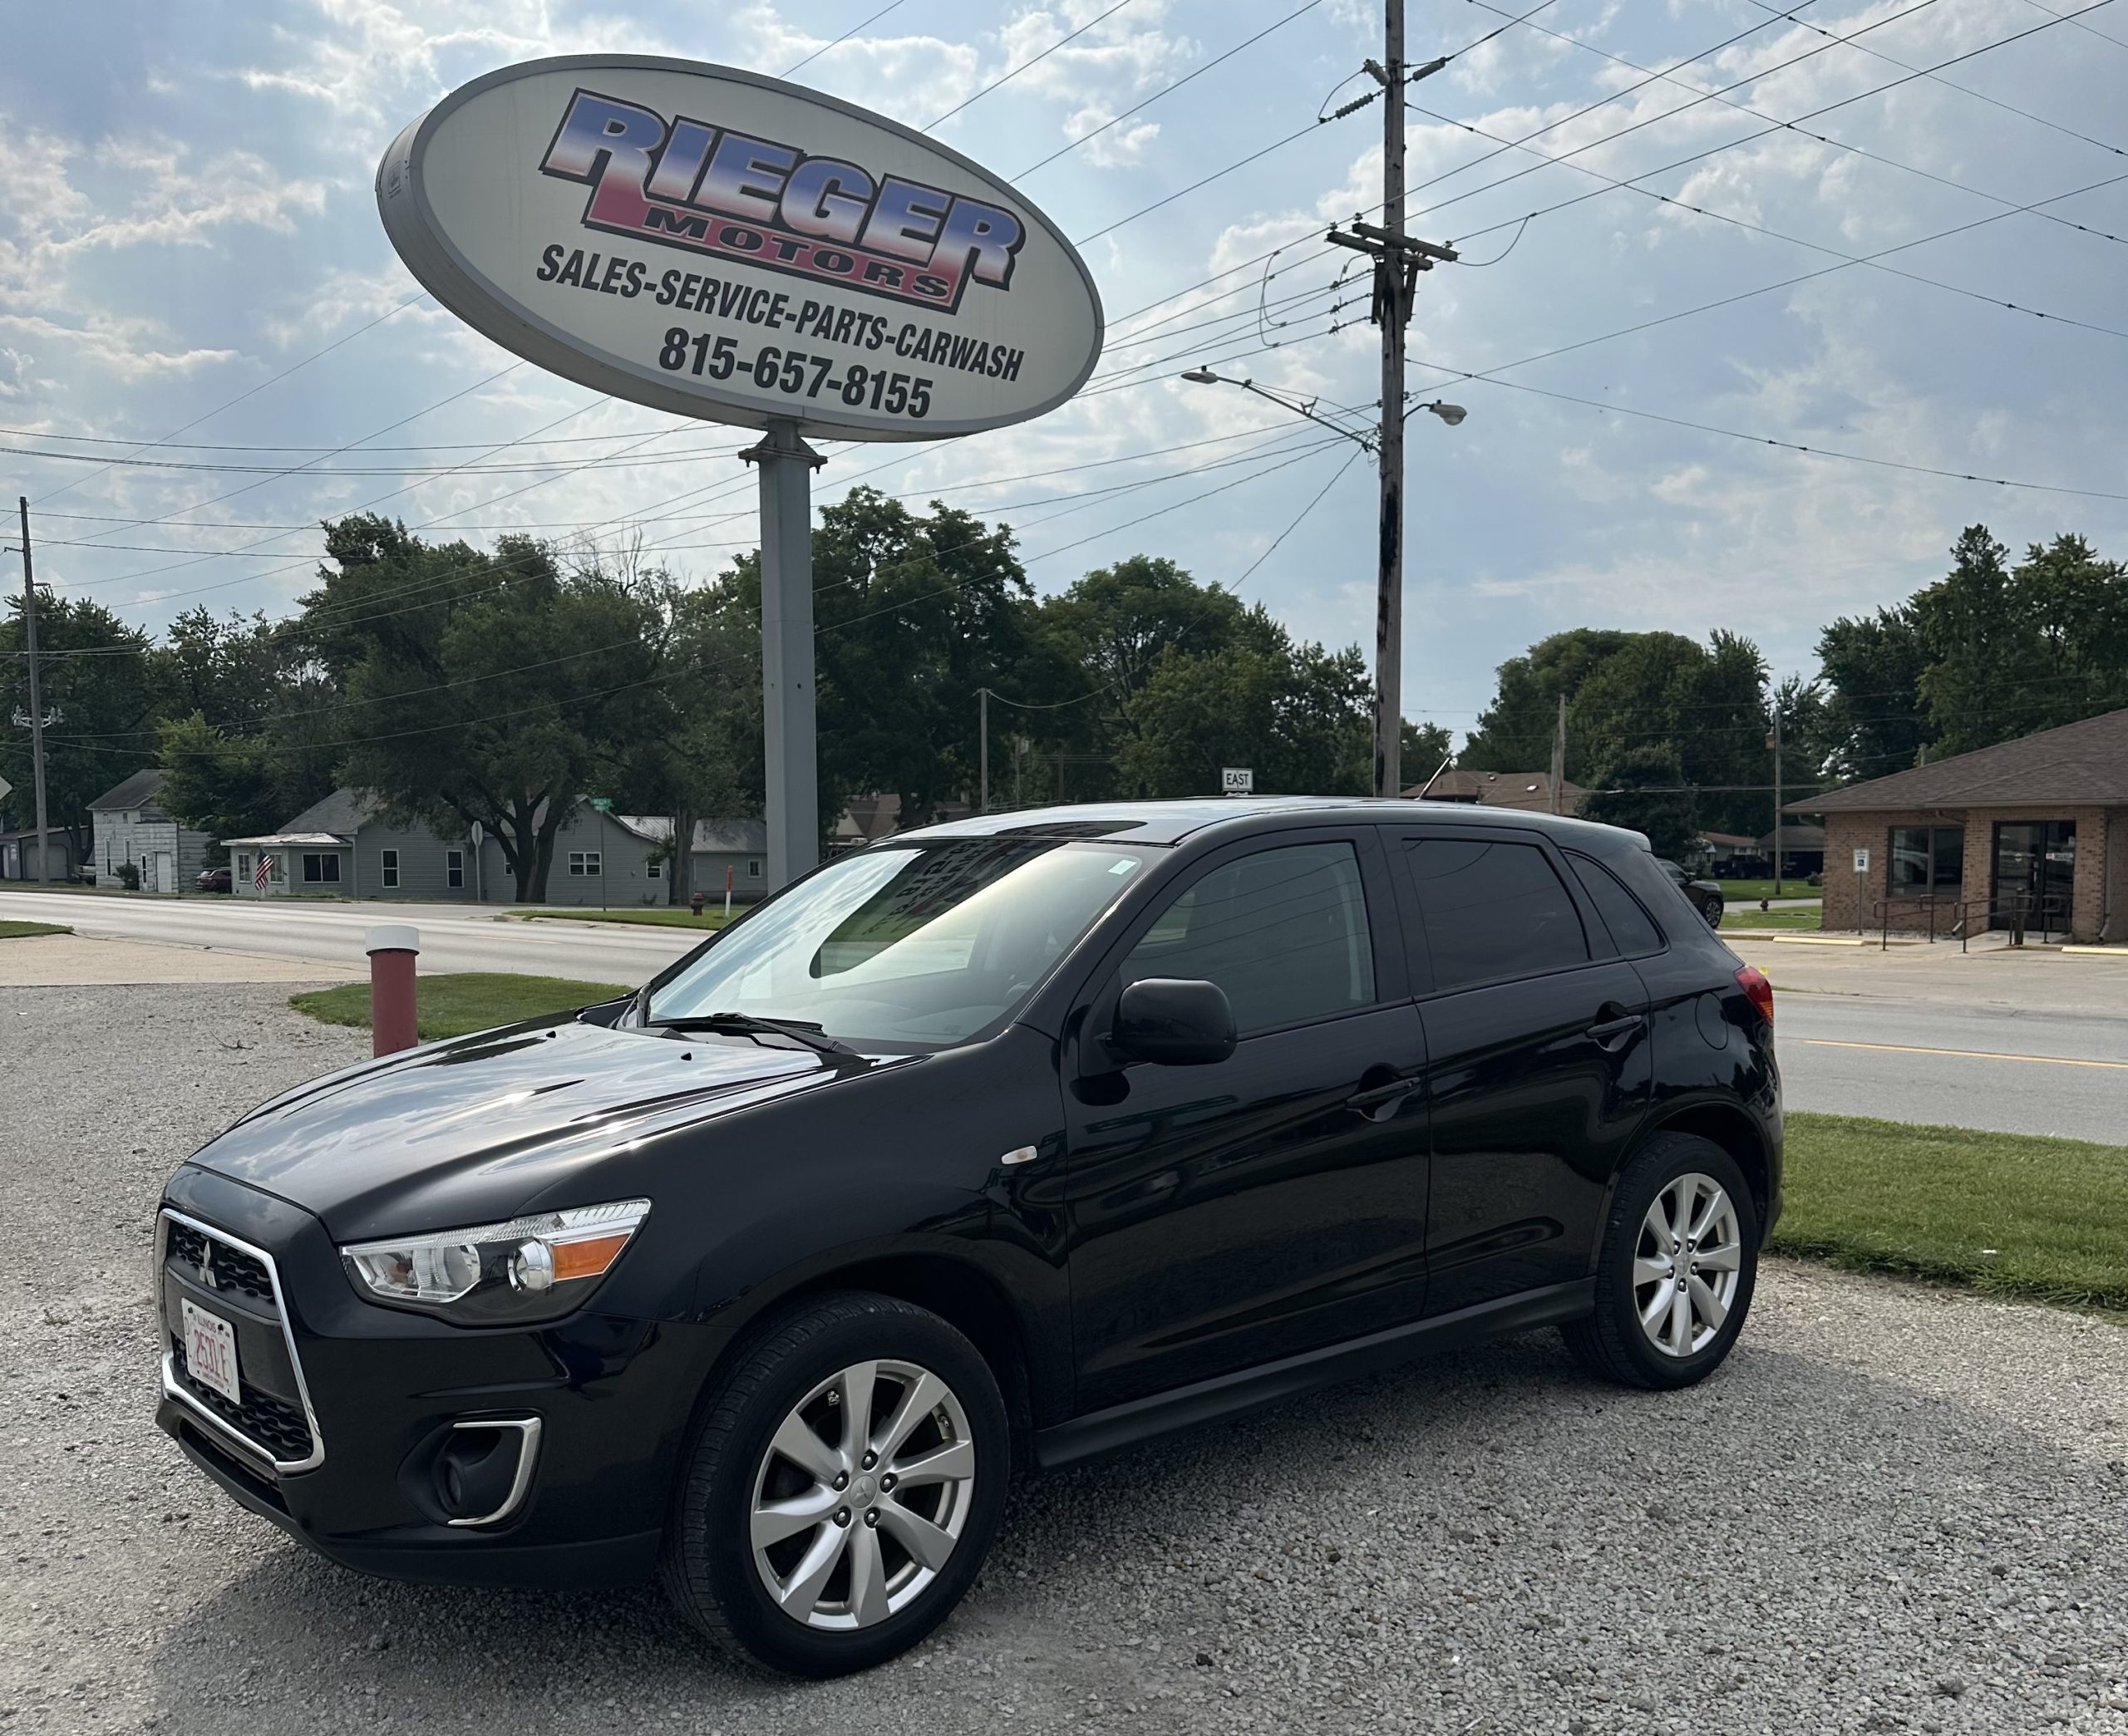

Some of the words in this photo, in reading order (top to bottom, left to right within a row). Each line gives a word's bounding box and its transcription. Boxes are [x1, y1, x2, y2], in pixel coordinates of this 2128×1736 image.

[540, 87, 1025, 291] RIEGER
[644, 207, 949, 298] MOTORS
[658, 327, 933, 418] 815-657-8155
[1226, 773, 1249, 785] EAST
